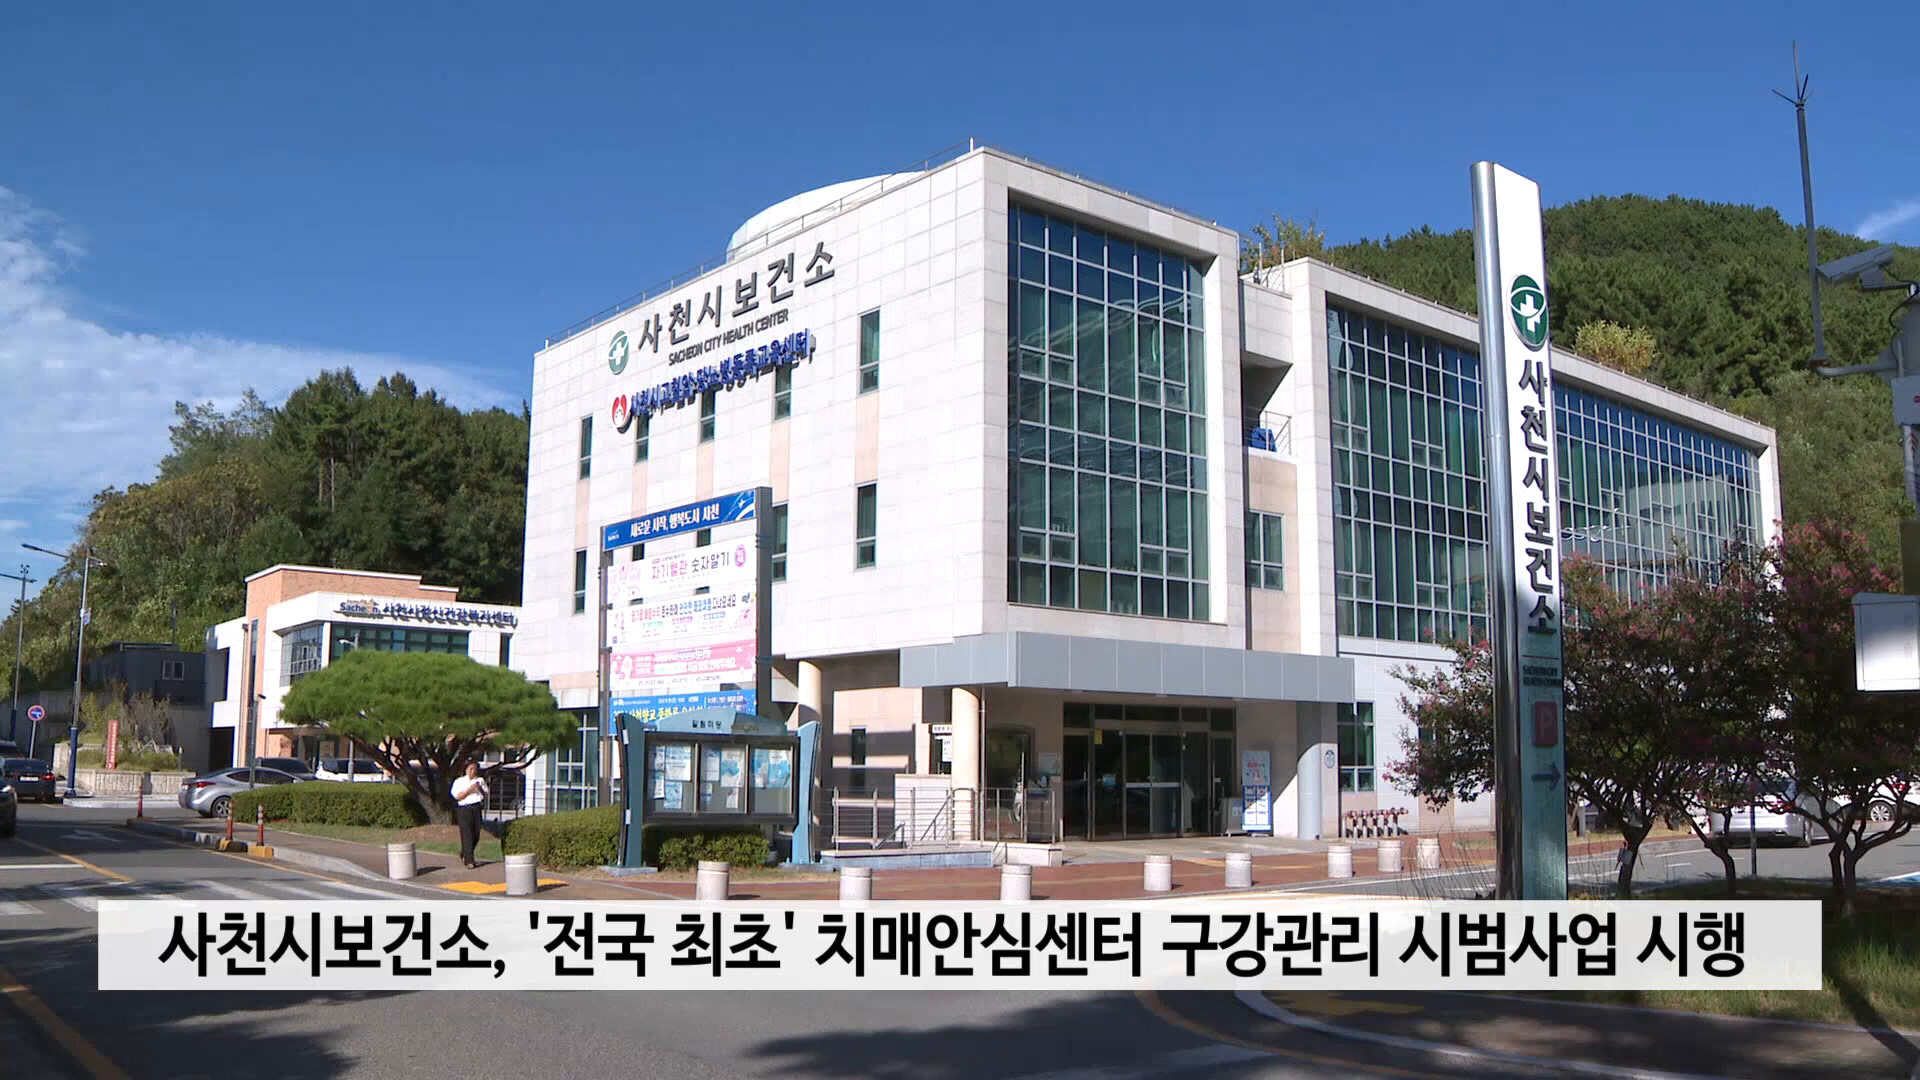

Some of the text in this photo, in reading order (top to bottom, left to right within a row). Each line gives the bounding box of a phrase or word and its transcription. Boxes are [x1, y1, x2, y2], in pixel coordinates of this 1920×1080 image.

[637, 241, 835, 353] 사천시보건소
[668, 308, 789, 366] SACHEON CITY HEALTH CENTER
[630, 520, 651, 538] 새로운
[669, 508, 700, 529] 행복도시
[702, 503, 720, 521] 사천
[1517, 360, 1557, 634] 사천시보건소
[651, 559, 688, 580] 자기혈관
[691, 551, 730, 573] 숫자알기
